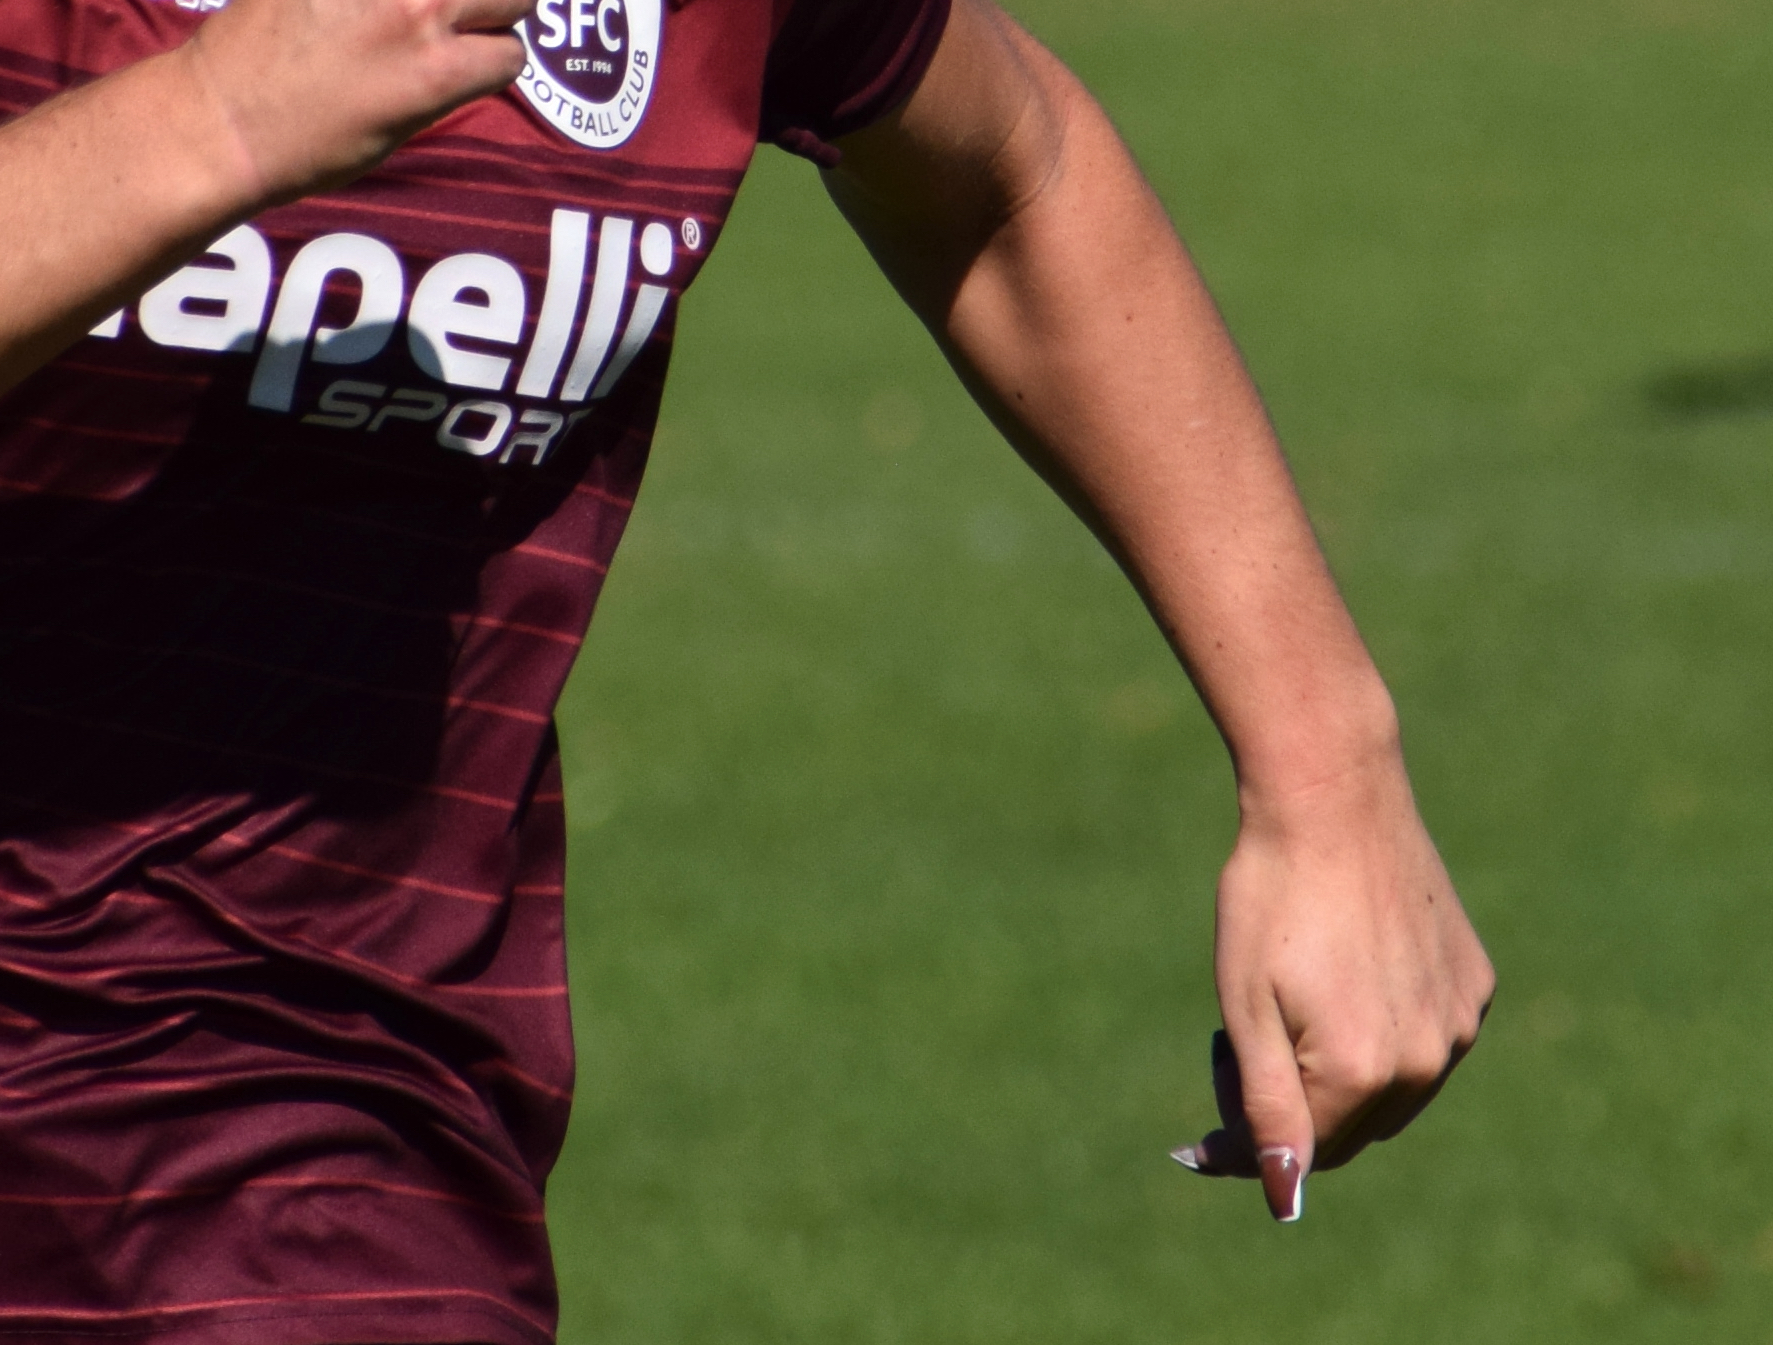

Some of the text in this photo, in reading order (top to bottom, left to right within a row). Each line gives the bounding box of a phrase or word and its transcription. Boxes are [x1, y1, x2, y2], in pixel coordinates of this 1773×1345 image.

[520, 49, 650, 137] OOTBALL CLUB
[565, 58, 590, 72] EST.
[88, 209, 673, 412] apelli
